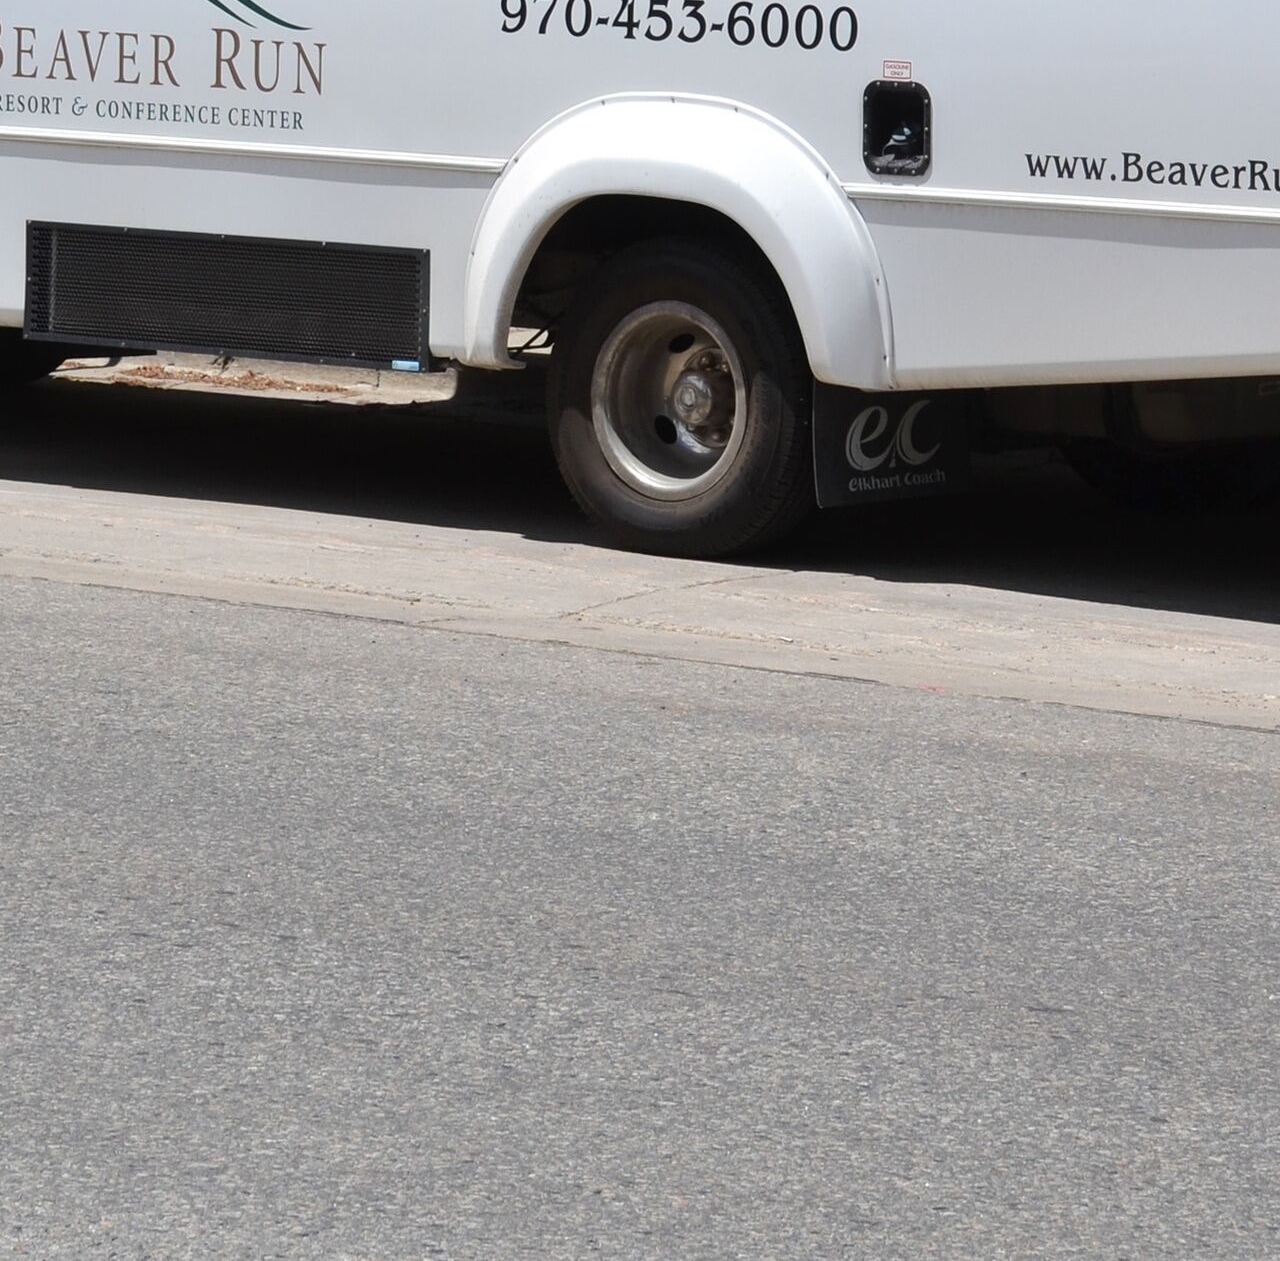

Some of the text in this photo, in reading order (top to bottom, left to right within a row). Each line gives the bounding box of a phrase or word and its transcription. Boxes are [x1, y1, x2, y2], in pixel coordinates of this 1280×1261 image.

[211, 28, 327, 95] RUN
[72, 98, 88, 116] &
[96, 100, 220, 125] CONFERENCE
[228, 107, 303, 129] CENTER
